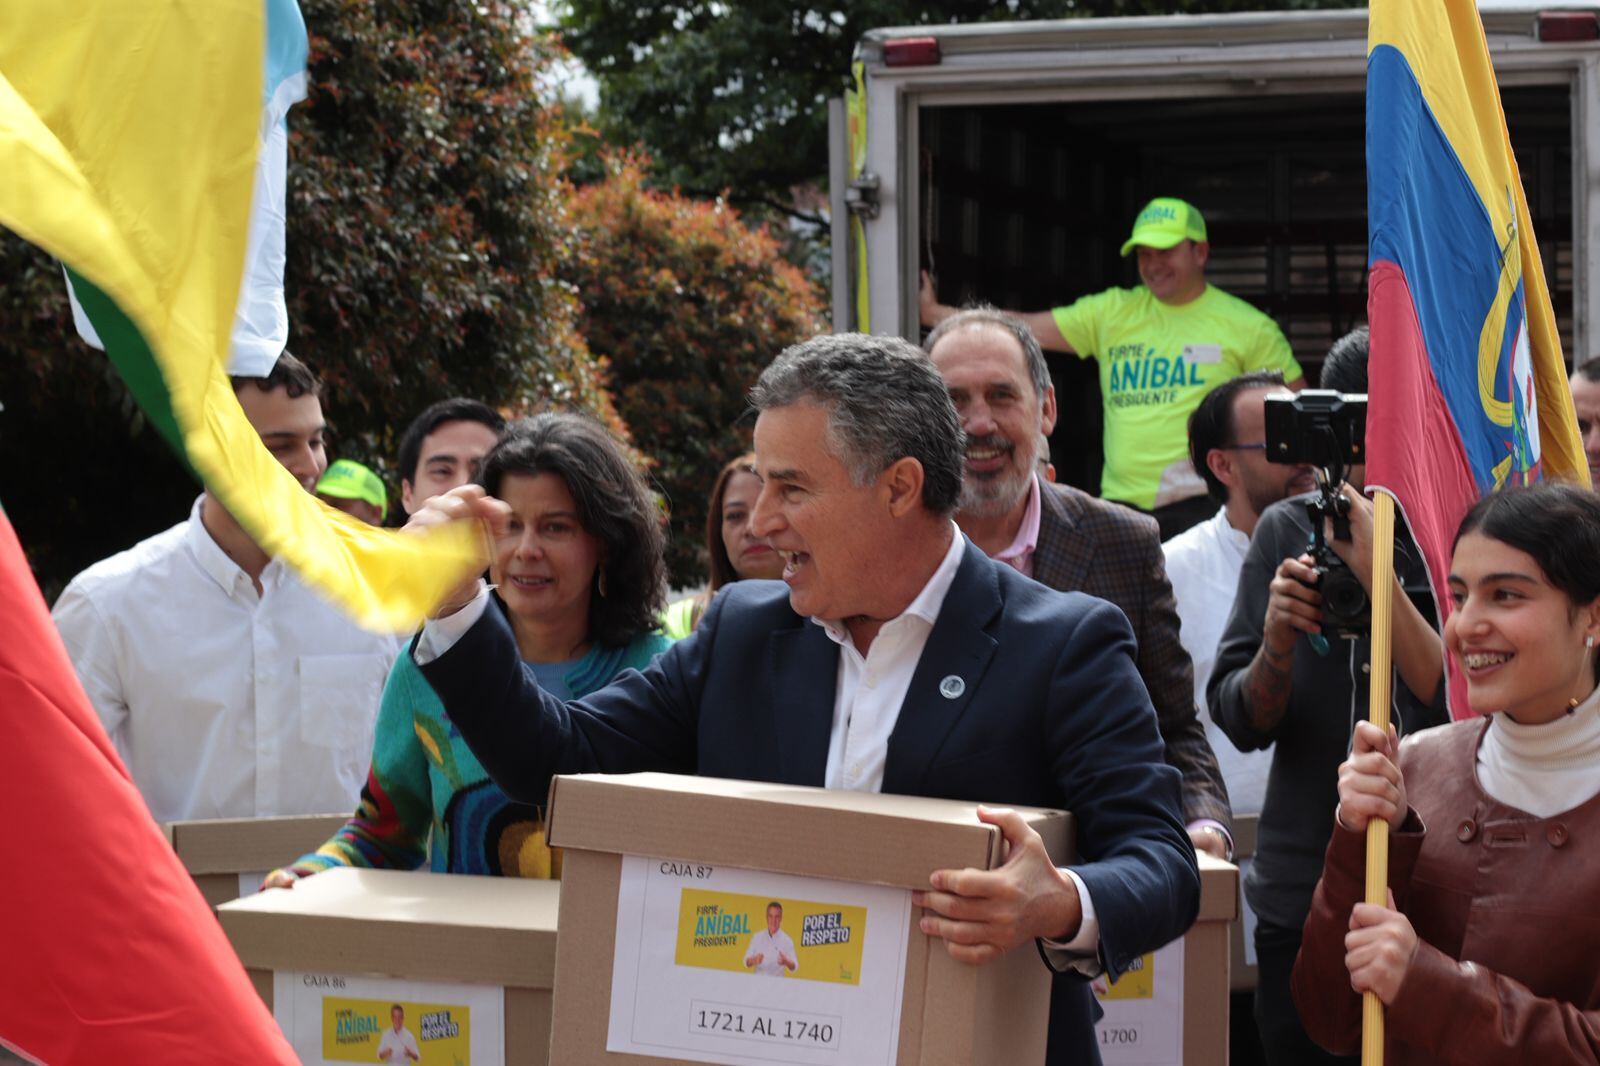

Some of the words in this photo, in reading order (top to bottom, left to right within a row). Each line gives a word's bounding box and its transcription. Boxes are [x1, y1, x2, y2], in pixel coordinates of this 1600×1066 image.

[1110, 347, 1205, 392] ANÍBAL
[660, 862, 692, 878] CAJA
[696, 866, 713, 879] 87
[696, 905, 718, 917] FIRME
[695, 908, 751, 936] ANÍBAL
[804, 915, 825, 931] POR
[827, 912, 840, 929] EL
[694, 935, 737, 949] PRESIDENTE
[802, 927, 849, 947] RESPETO
[303, 974, 330, 988] CAJA
[332, 976, 346, 989] 86
[697, 1010, 745, 1033] 1721
[751, 1016, 776, 1037] AL
[783, 1020, 833, 1044] 1740
[1102, 1027, 1138, 1045] 1700
